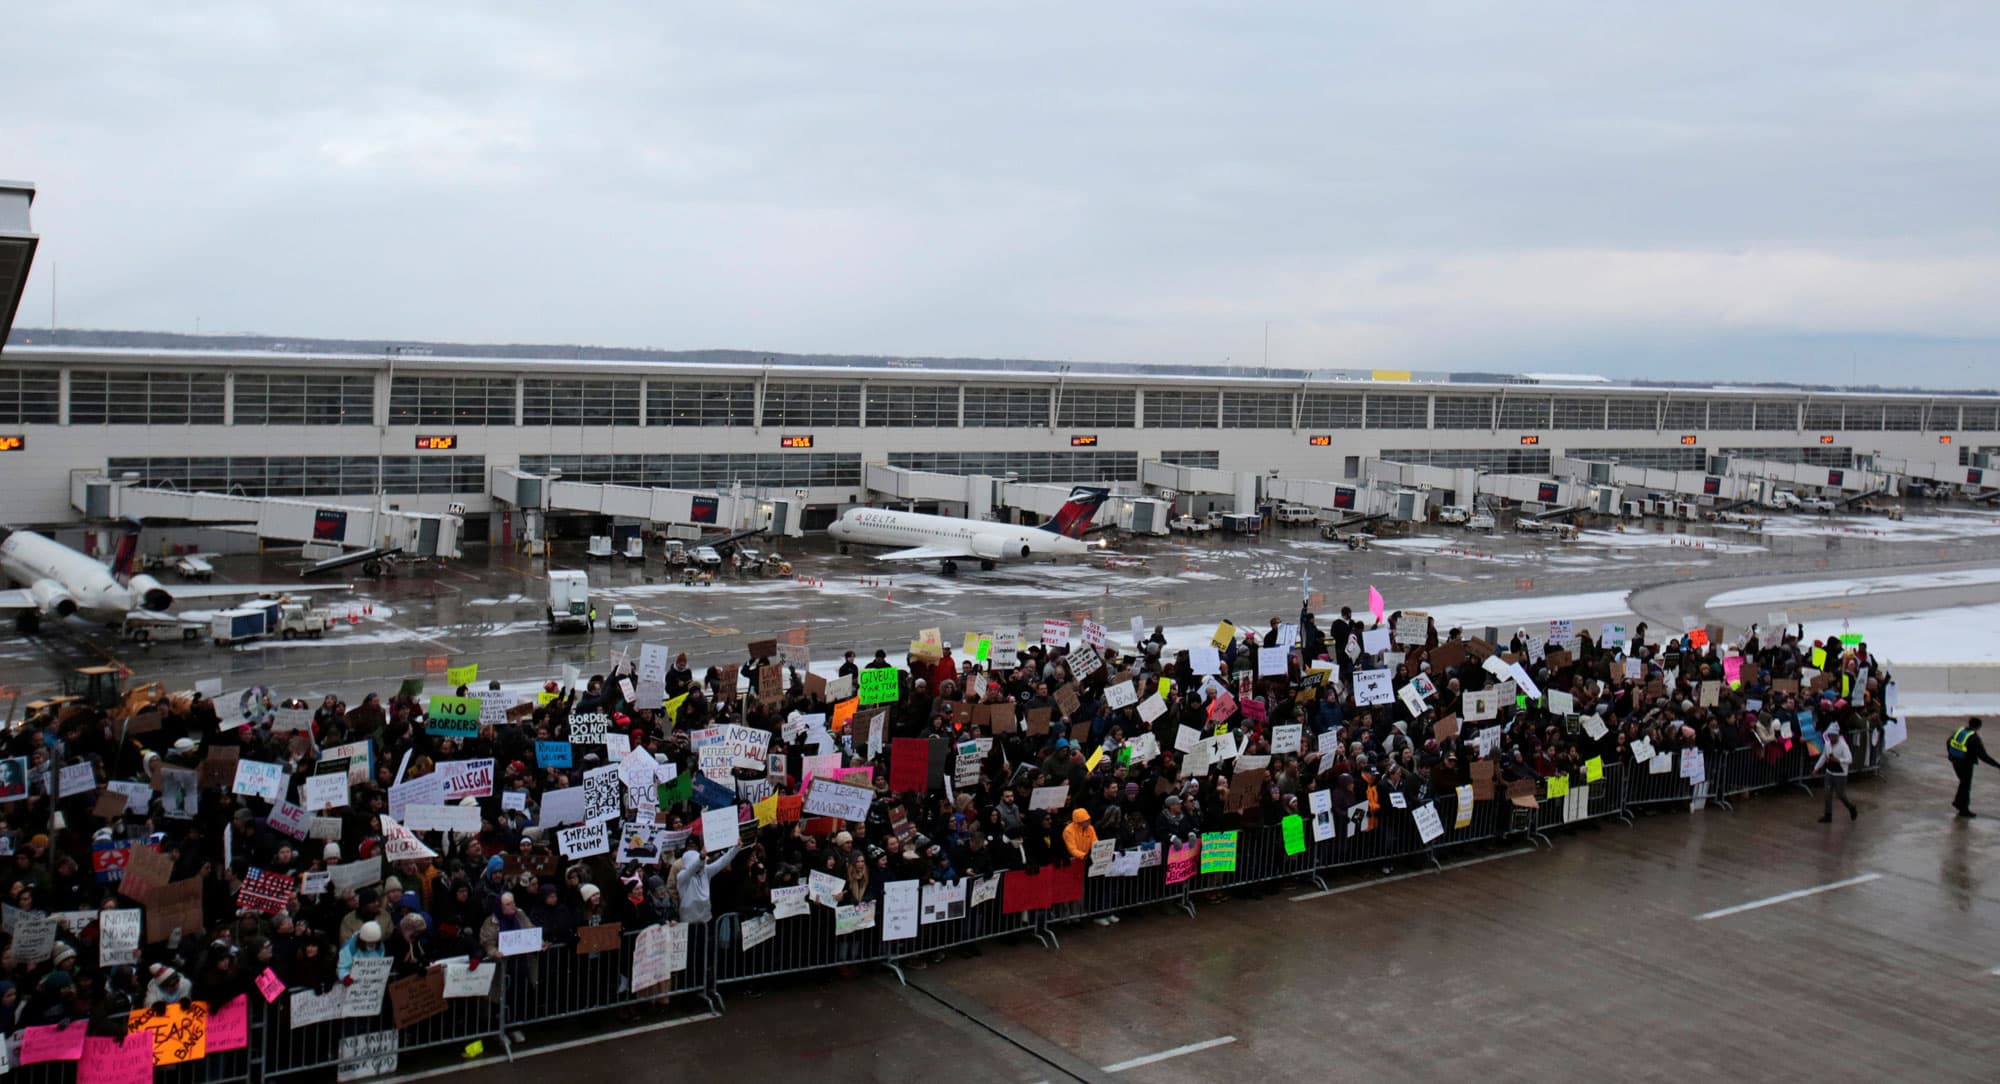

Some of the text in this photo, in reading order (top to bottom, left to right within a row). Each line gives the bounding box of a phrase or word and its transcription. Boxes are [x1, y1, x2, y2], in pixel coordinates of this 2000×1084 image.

[449, 504, 465, 514] A47
[864, 514, 897, 524] DELTA
[860, 671, 882, 685] GIVE
[1360, 691, 1389, 703] SECURITY
[440, 703, 466, 716] NO
[429, 718, 477, 731] BORDERS
[568, 713, 608, 725] BORDERS
[571, 724, 608, 736] DO NOT
[729, 728, 770, 746] NO BAN
[743, 744, 768, 762] WALL
[466, 760, 492, 769] PERSON
[705, 767, 728, 778] HERE
[451, 768, 492, 791] ILLEGAL
[811, 783, 830, 793] LET
[280, 802, 304, 823] WE
[563, 824, 604, 843] IMPEACH
[567, 838, 602, 853] TRUMP
